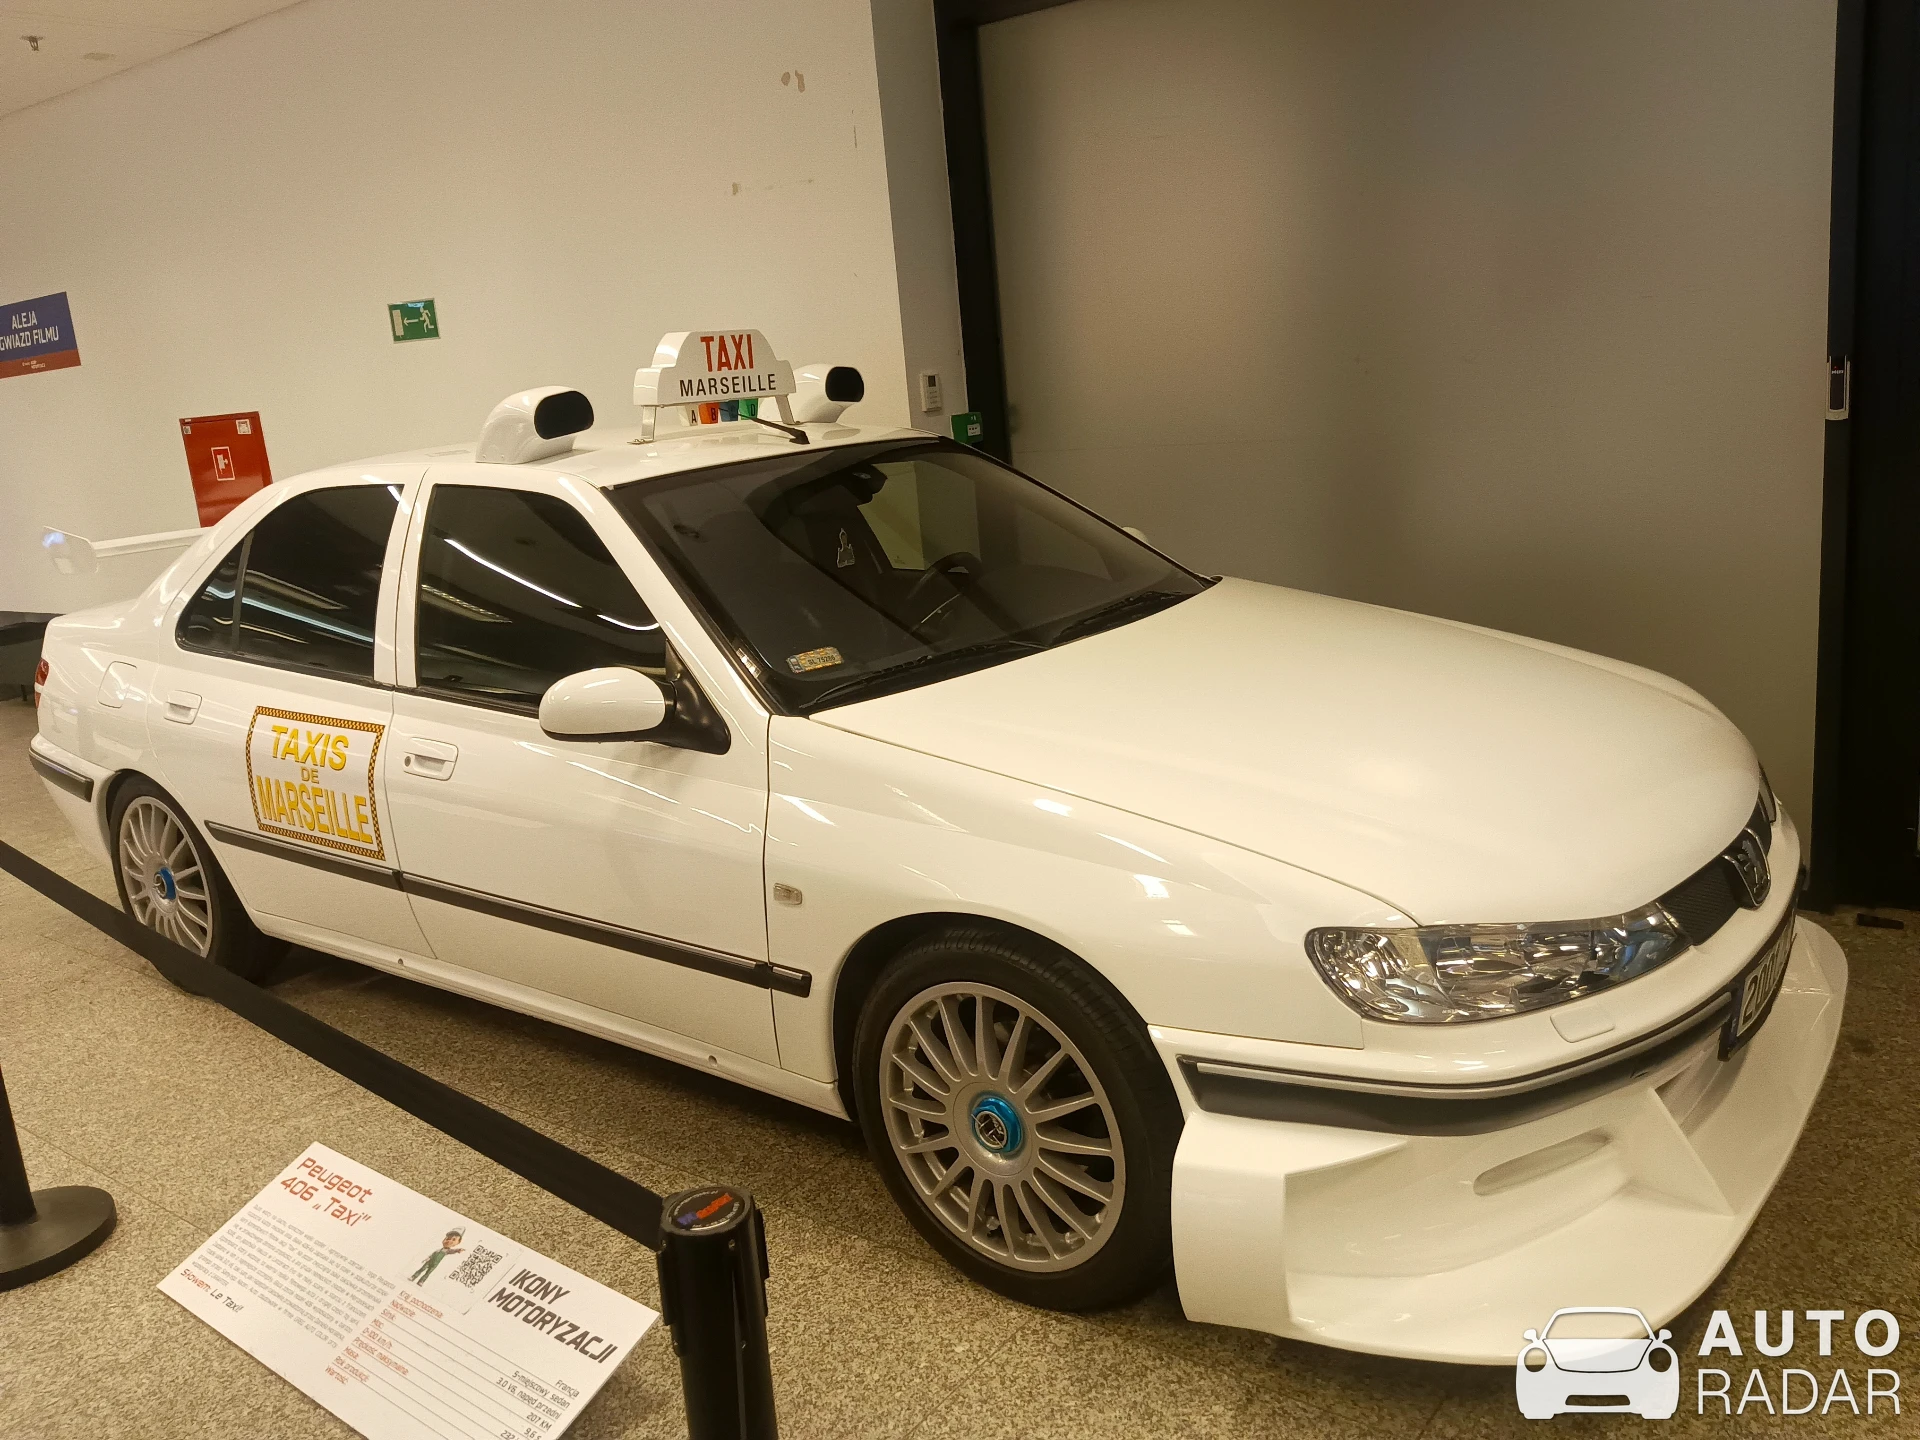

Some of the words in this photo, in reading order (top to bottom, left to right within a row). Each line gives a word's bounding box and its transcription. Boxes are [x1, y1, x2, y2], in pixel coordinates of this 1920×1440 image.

[12, 310, 38, 330] ALEJA
[33, 326, 59, 344] FILMU
[700, 334, 754, 372] TAXI
[679, 373, 777, 397] MARSEILLE
[691, 410, 697, 424] A
[711, 408, 716, 421] B
[750, 404, 756, 417] D
[271, 725, 350, 771] TAXIS
[300, 767, 319, 784] DE
[256, 775, 373, 844] MARSEILLE
[280, 1177, 319, 1201] 406
[296, 1157, 373, 1203] Peugeot
[508, 1268, 571, 1305] IKONY
[210, 1289, 223, 1300] Le
[222, 1296, 244, 1313] Taxi!
[487, 1287, 618, 1364] MOTORYZACJI
[496, 1377, 509, 1388] 3.0
[517, 1390, 538, 1407] napęd
[534, 1402, 562, 1421] przedni
[512, 1370, 550, 1397] 5-miejscowy
[550, 1393, 570, 1409] sedan
[555, 1379, 580, 1399] Francja
[523, 1427, 537, 1440] 9,6
[526, 1412, 542, 1424] 207
[539, 1420, 552, 1431] KM
